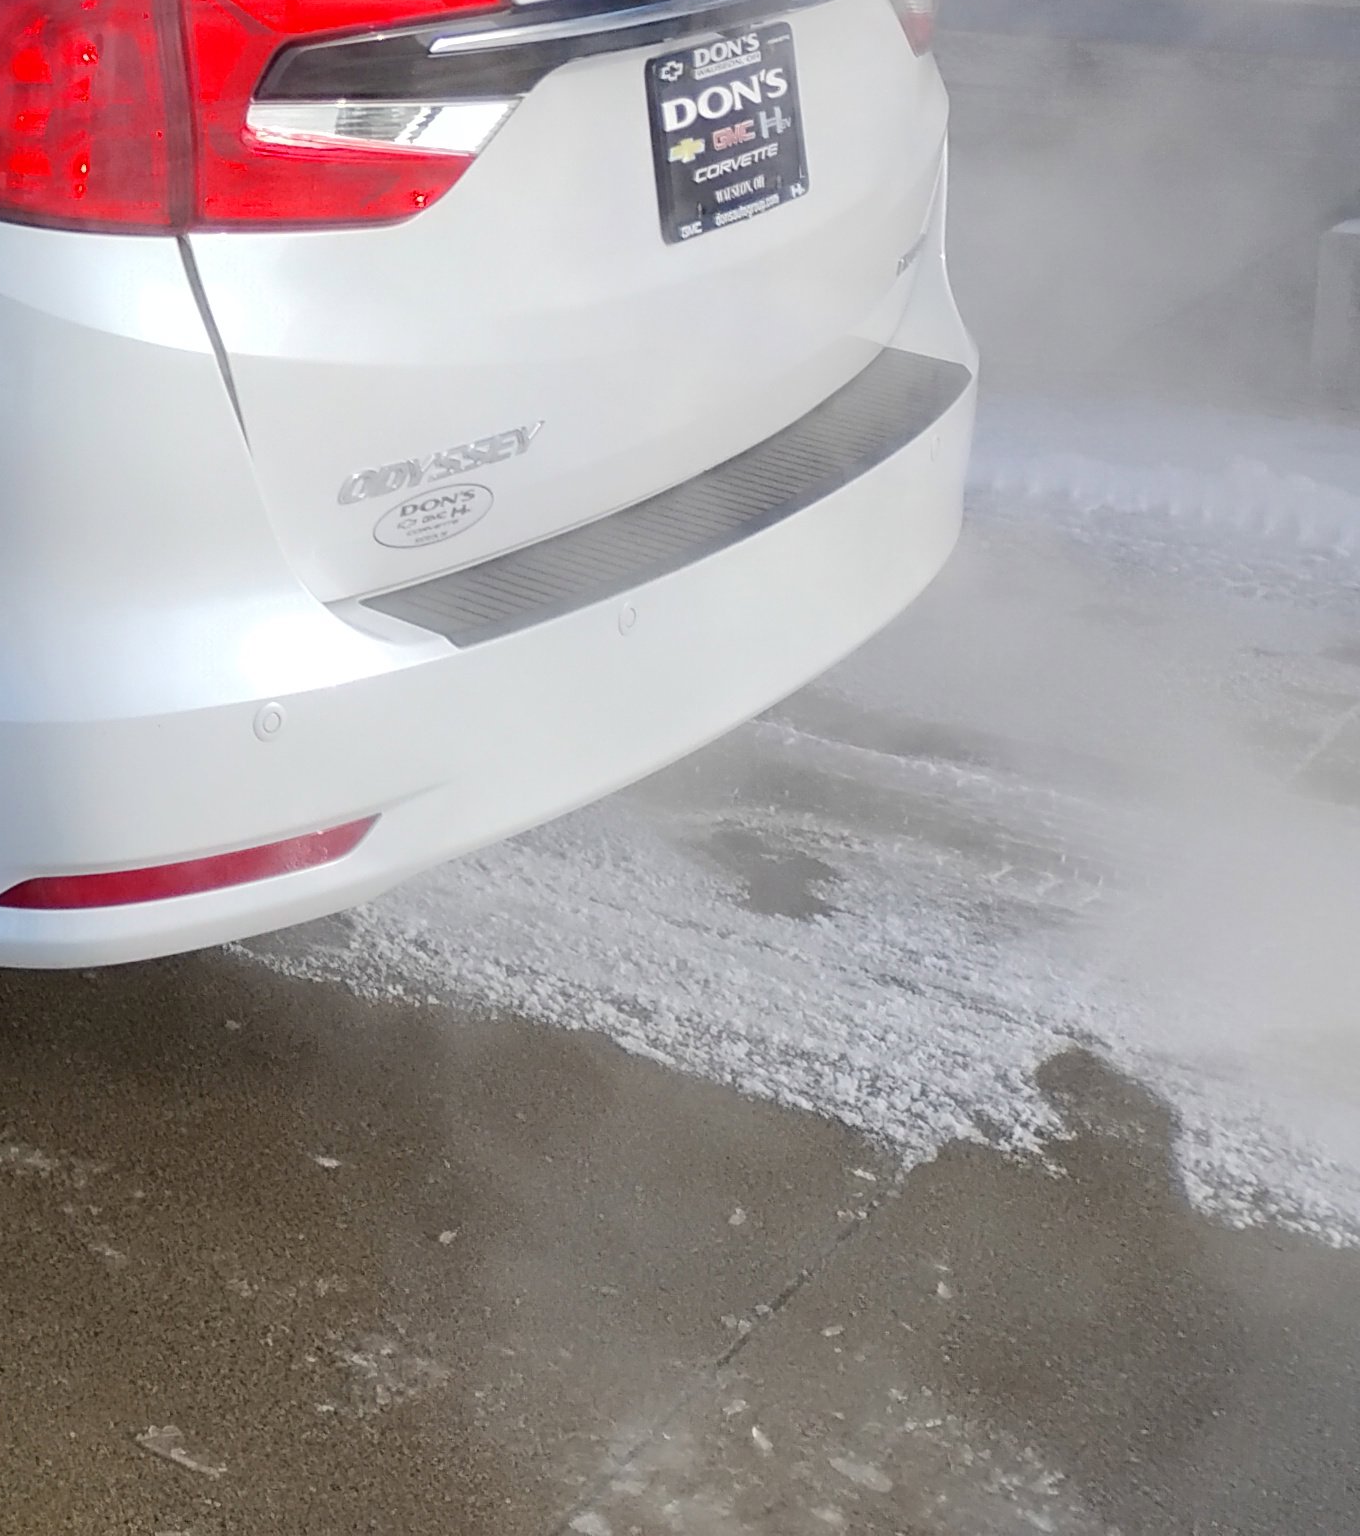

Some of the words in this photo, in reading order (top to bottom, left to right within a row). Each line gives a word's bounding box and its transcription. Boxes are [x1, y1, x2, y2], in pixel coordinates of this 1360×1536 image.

[693, 32, 760, 68] DON'S
[661, 68, 788, 132] DON'S
[712, 120, 756, 151] GMC
[693, 142, 779, 184] CORVETTE
[337, 420, 546, 506] ODYSSEY
[399, 488, 476, 518] DON'S
